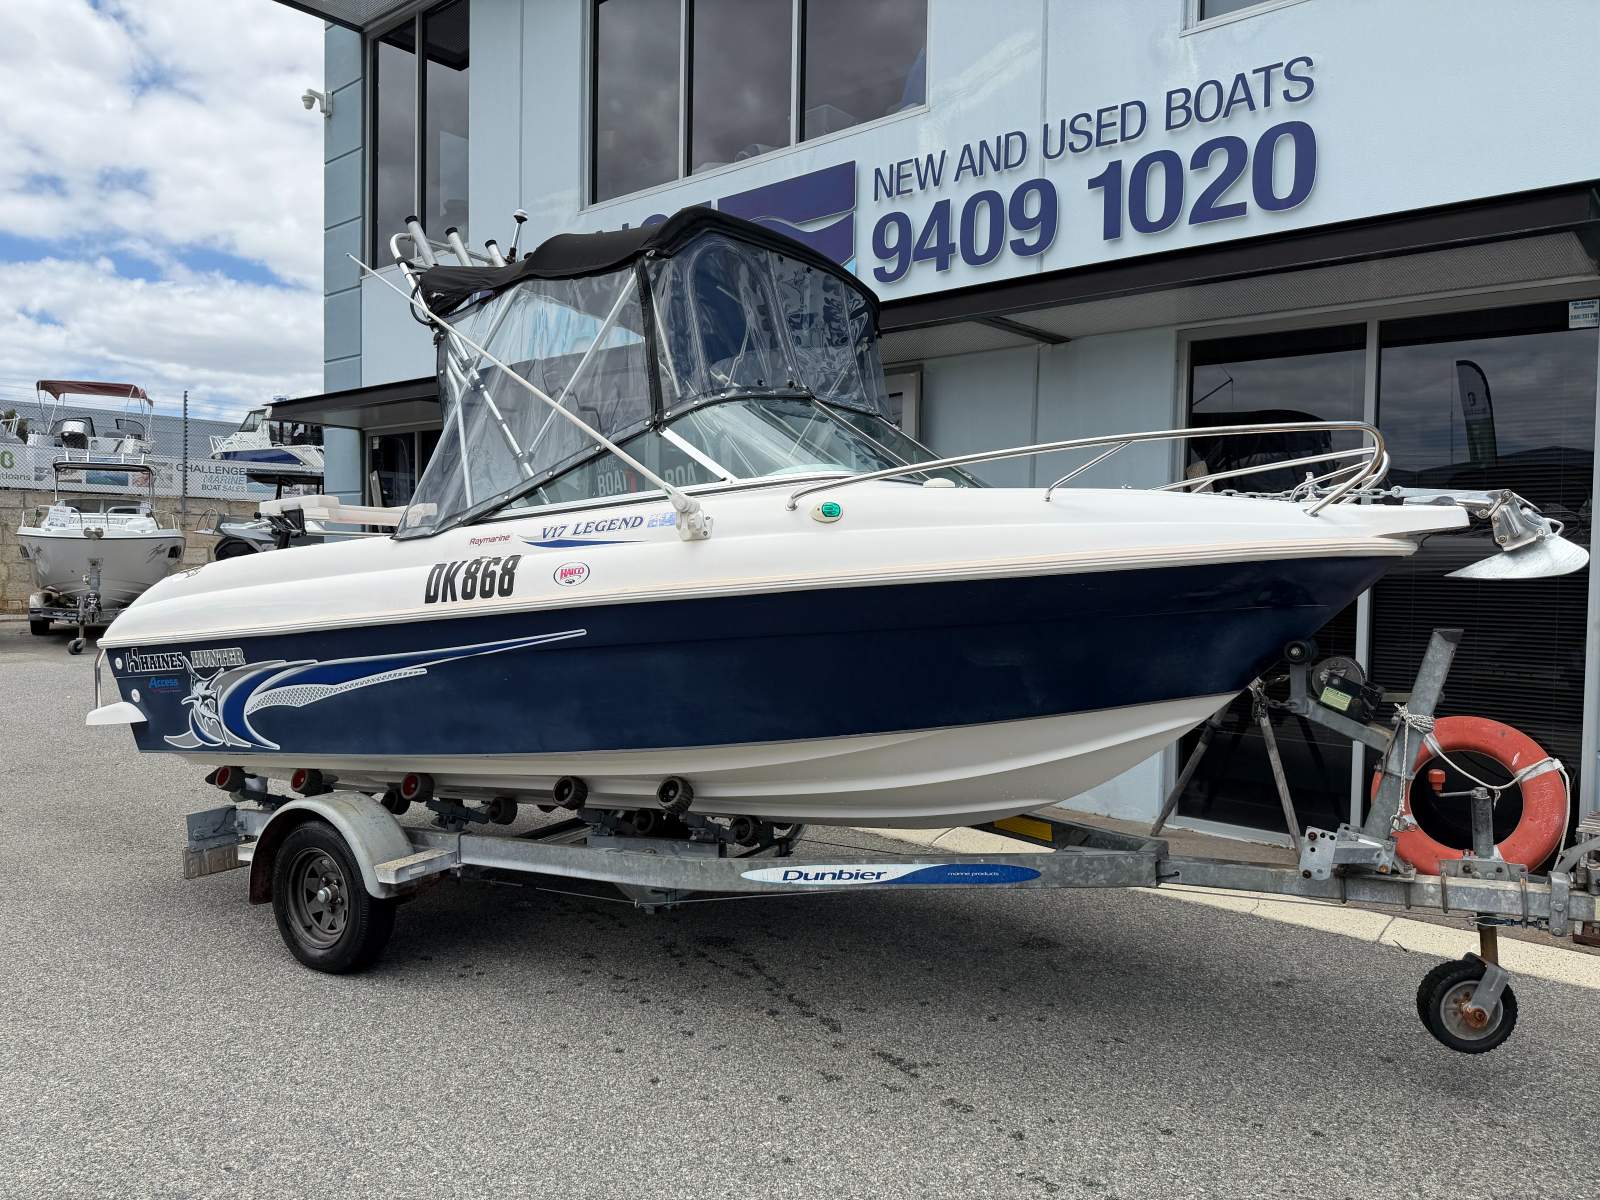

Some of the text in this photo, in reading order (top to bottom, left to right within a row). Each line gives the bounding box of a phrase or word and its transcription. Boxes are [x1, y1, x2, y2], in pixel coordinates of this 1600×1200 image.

[873, 56, 1316, 200] NEW AND USED BOATS
[871, 120, 1318, 283] 9409 1020
[176, 463, 246, 476] CHALLENGE
[664, 461, 698, 486] BOA
[542, 516, 644, 540] V17 LEGEND
[469, 534, 511, 547] Raymarine
[424, 555, 522, 604] DK868
[139, 648, 246, 671] HAINES HUNTER
[148, 677, 179, 689] Access
[782, 868, 889, 881] Dunbier
